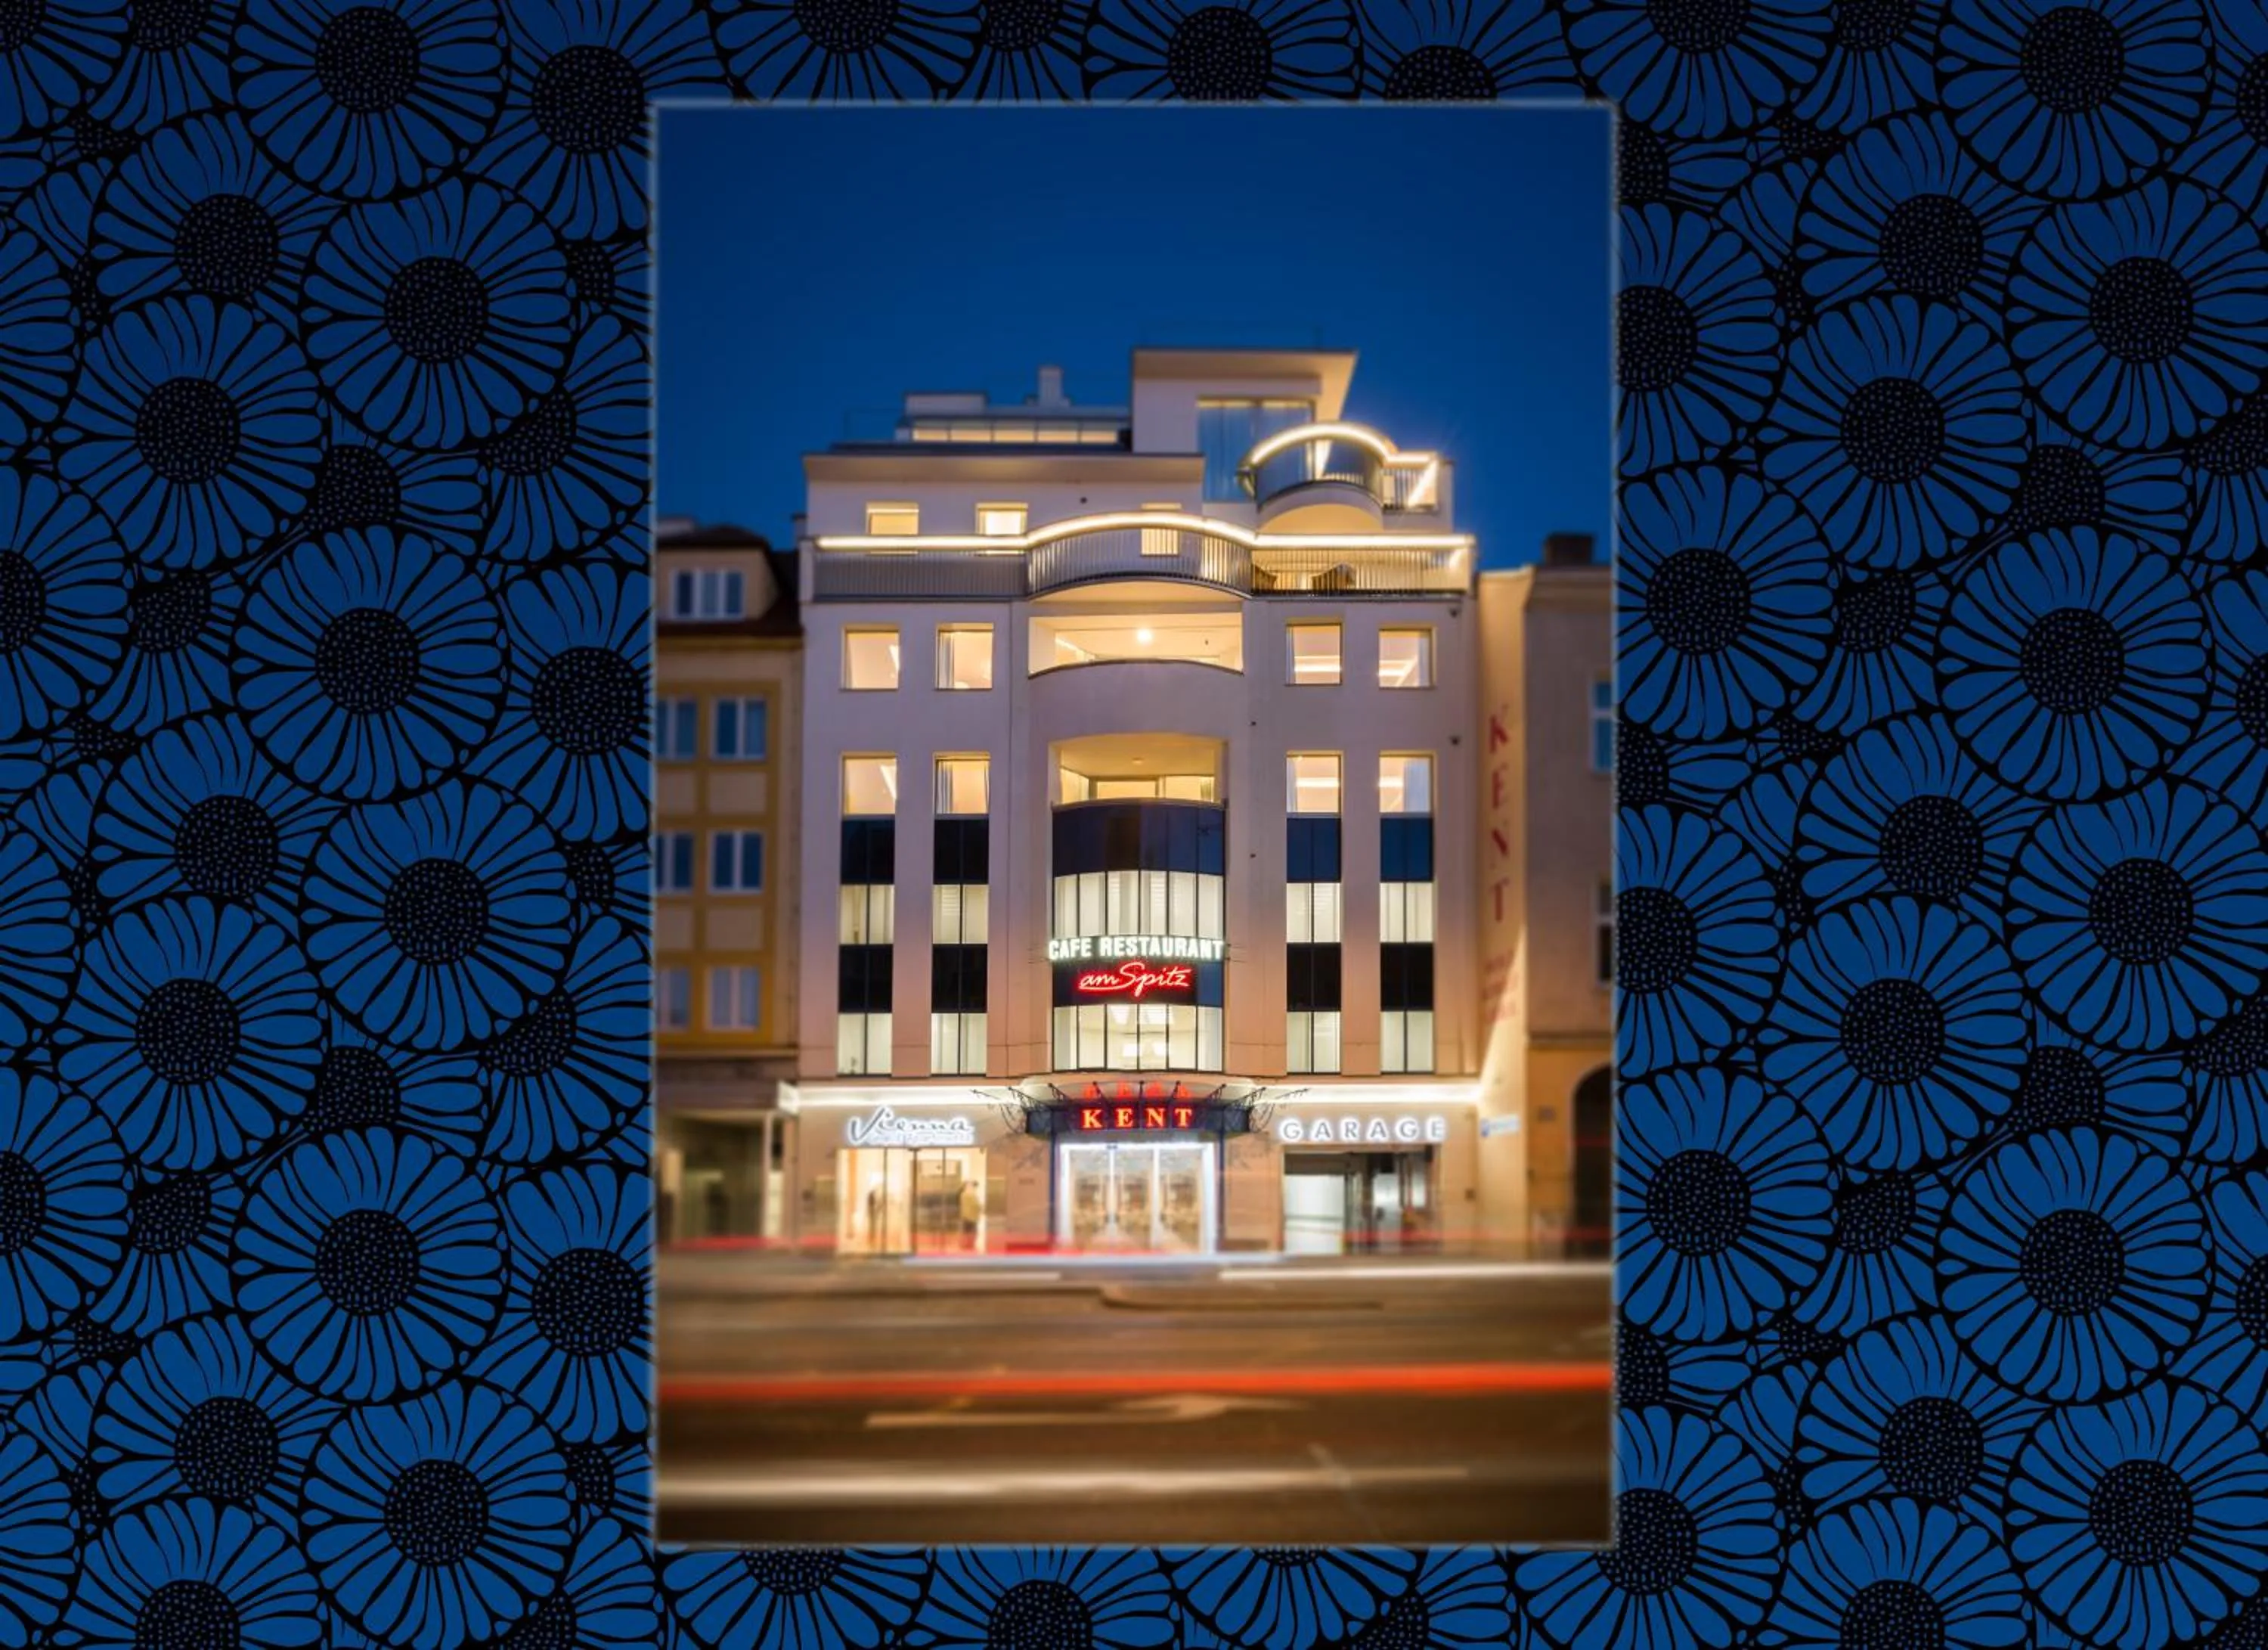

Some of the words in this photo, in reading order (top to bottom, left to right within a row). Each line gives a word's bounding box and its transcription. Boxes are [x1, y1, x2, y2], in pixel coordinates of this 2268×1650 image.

[1048, 938, 1092, 960] CAFE
[1098, 936, 1223, 959] RESTAURANT
[1079, 972, 1121, 990] am
[1118, 961, 1191, 997] Spitz
[847, 1106, 973, 1143] Vienna
[1082, 1107, 1192, 1129] KENT
[1281, 1115, 1445, 1141] GARAGE
